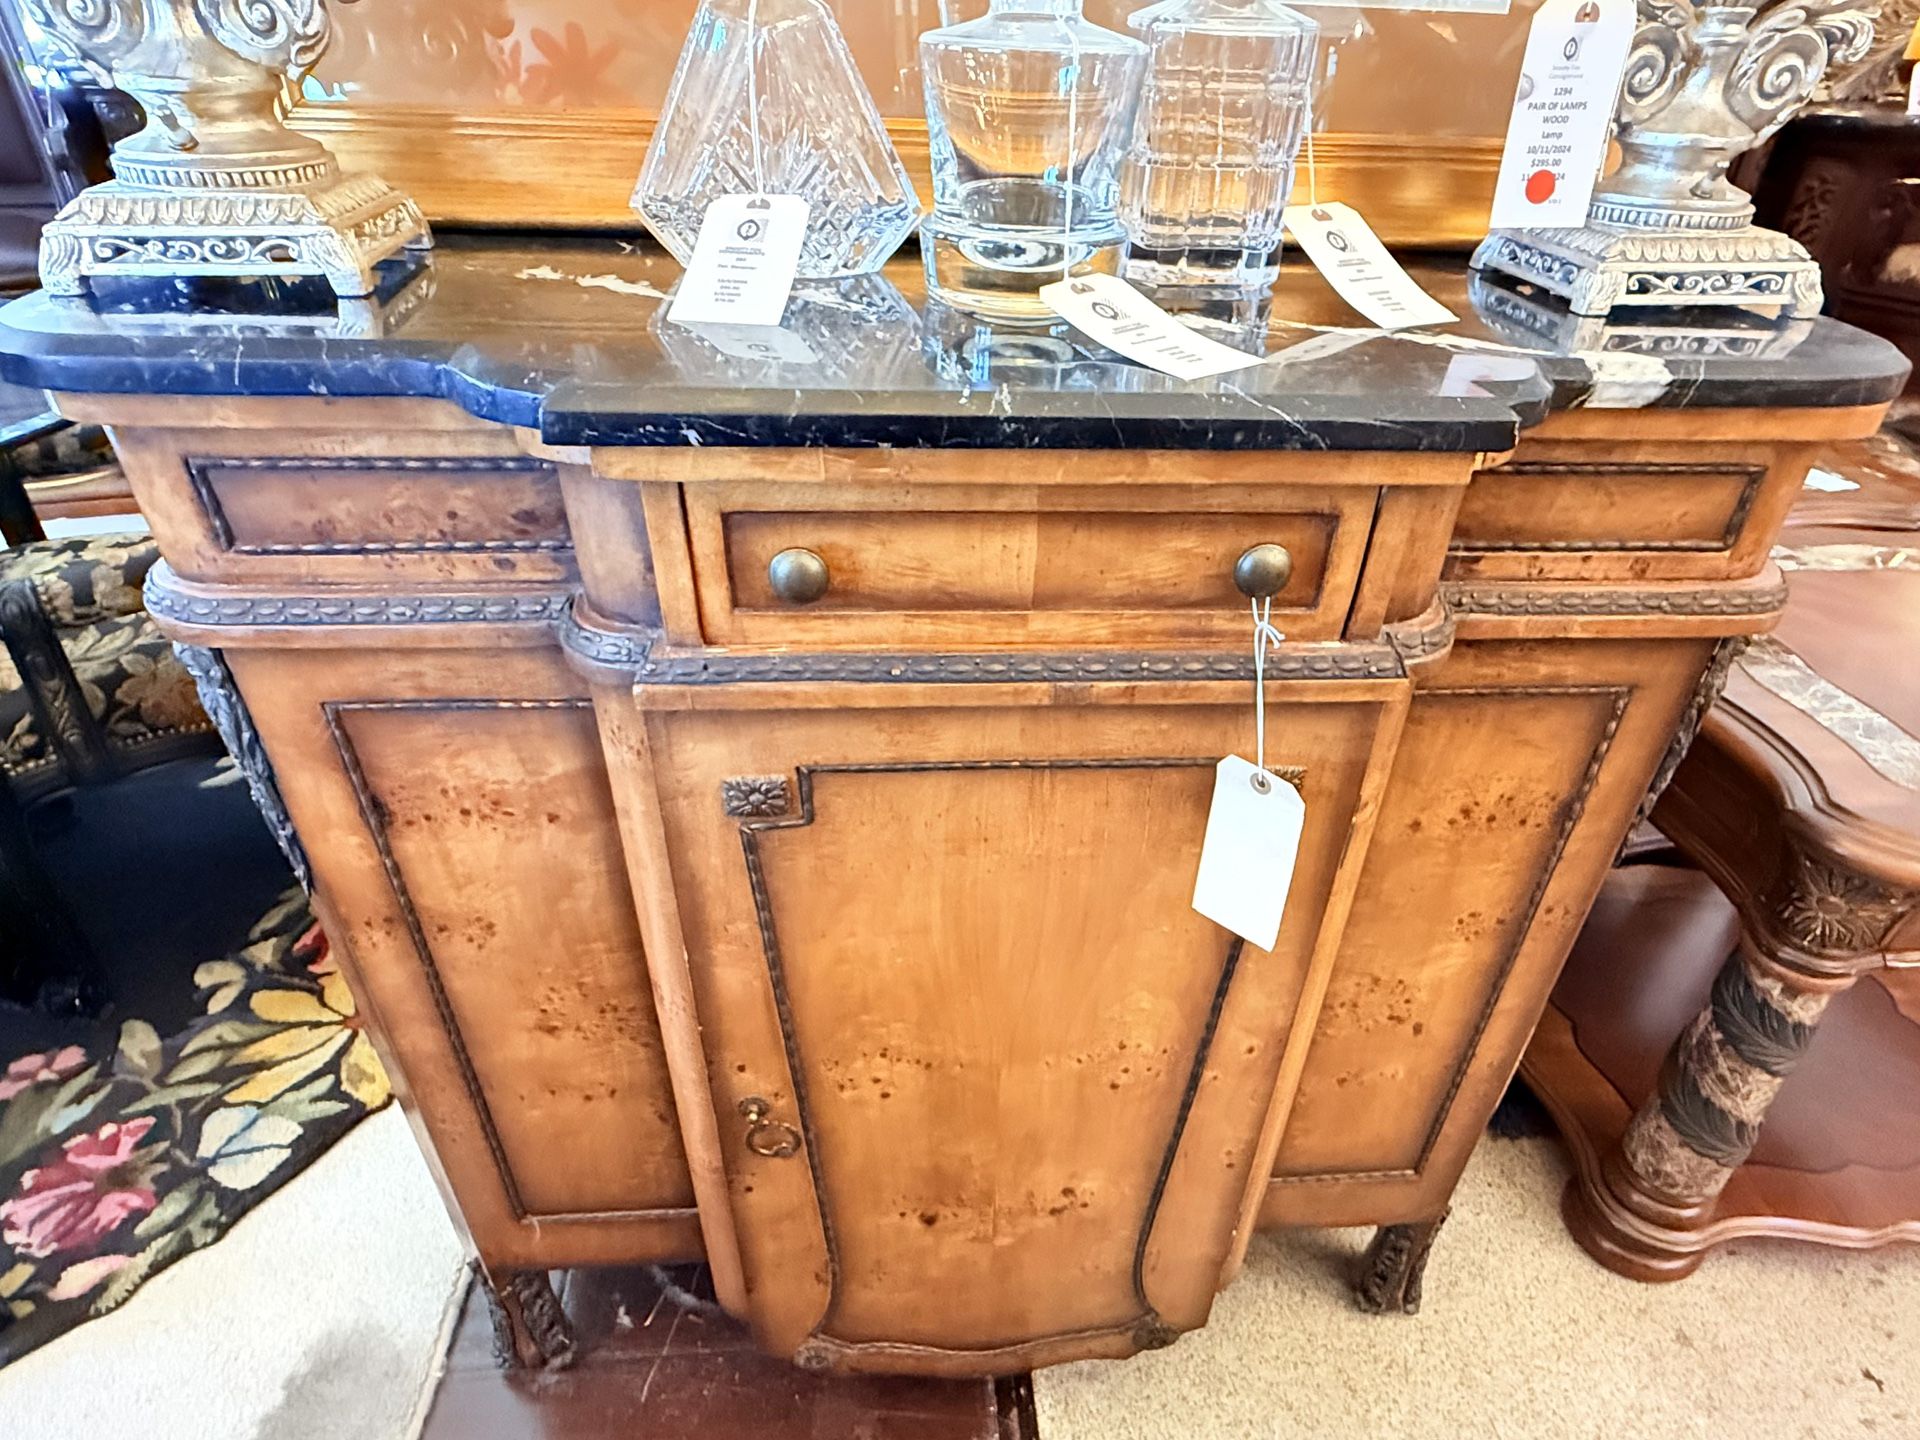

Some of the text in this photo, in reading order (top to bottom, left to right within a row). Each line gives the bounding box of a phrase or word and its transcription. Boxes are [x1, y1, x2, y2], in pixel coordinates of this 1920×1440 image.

[1554, 87, 1573, 96] 1294
[1527, 101, 1588, 111] PAIR OF LAMPS
[1542, 115, 1570, 124] WOOD
[1541, 131, 1563, 140] Lamp
[1526, 145, 1572, 154] 10/11/2024
[1530, 158, 1562, 168] $295.00
